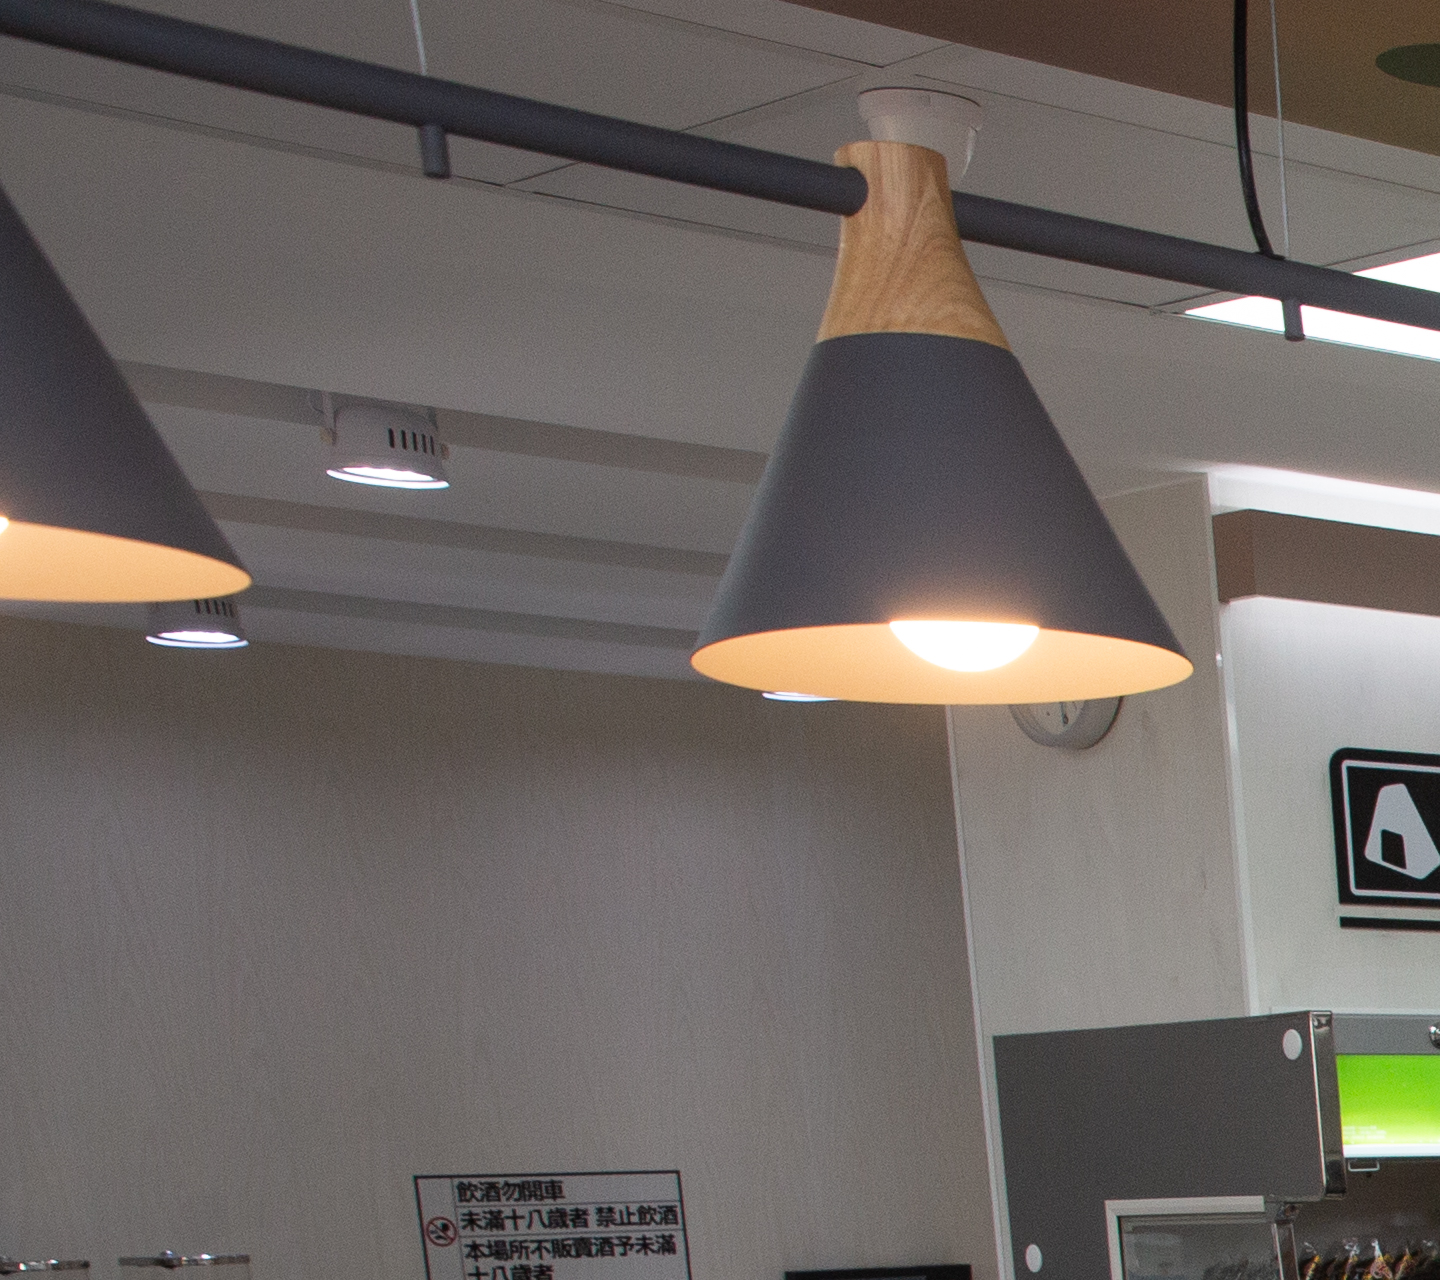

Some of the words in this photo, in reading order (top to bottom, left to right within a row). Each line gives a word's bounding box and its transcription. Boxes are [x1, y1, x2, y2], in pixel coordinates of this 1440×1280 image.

[456, 1180, 566, 1203] 飲酒勿開車
[460, 1206, 589, 1231] 未滿十八歲者
[595, 1203, 679, 1227] 禁止飲酒
[464, 1234, 677, 1262] 本場所不販賣酒予未滿
